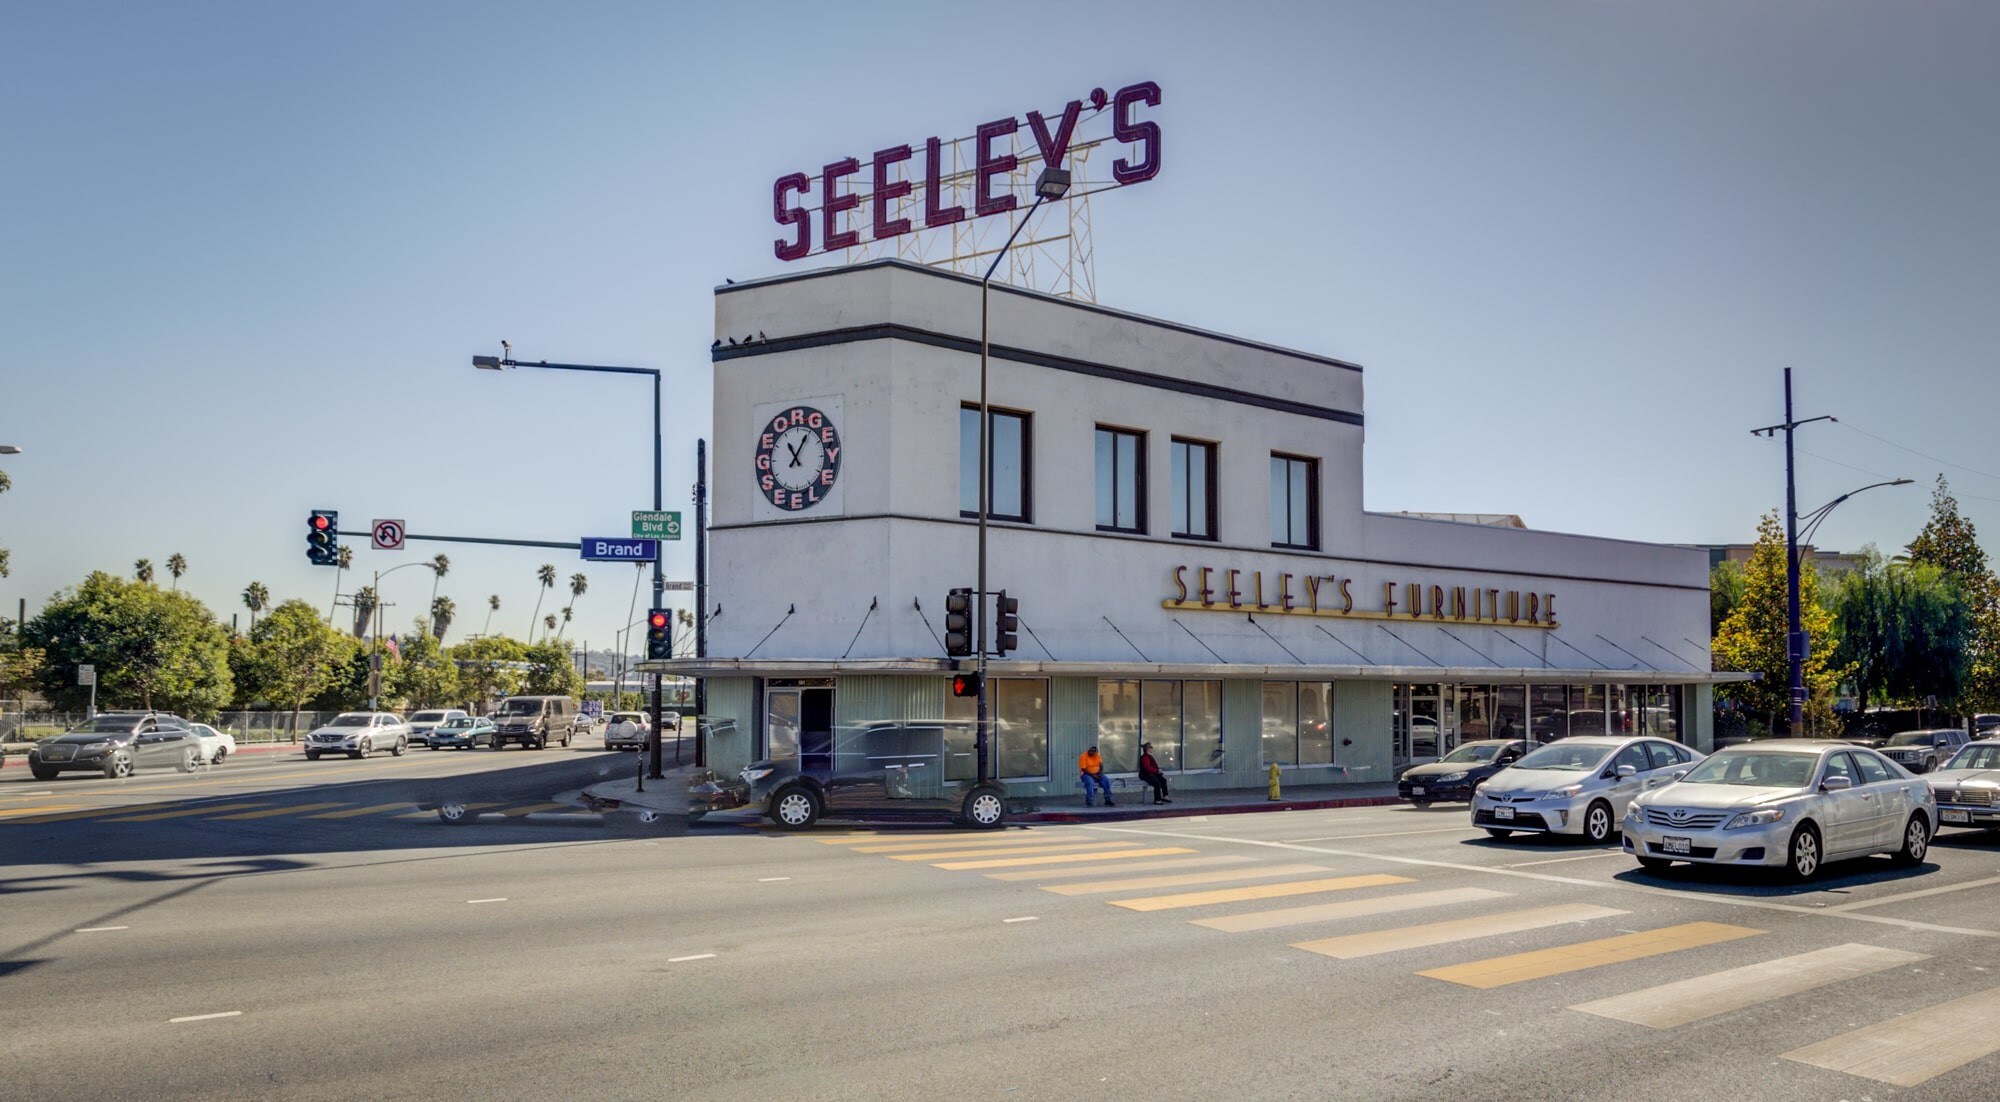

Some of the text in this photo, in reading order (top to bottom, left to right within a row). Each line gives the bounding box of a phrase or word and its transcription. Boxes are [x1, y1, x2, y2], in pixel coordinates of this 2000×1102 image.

[774, 81, 1162, 261] SEELEY'S
[633, 512, 673, 521] Glendale
[642, 522, 663, 531] Blvd
[595, 541, 643, 556] Brand
[1174, 565, 1558, 626] SEELEY'S FURNITURE
